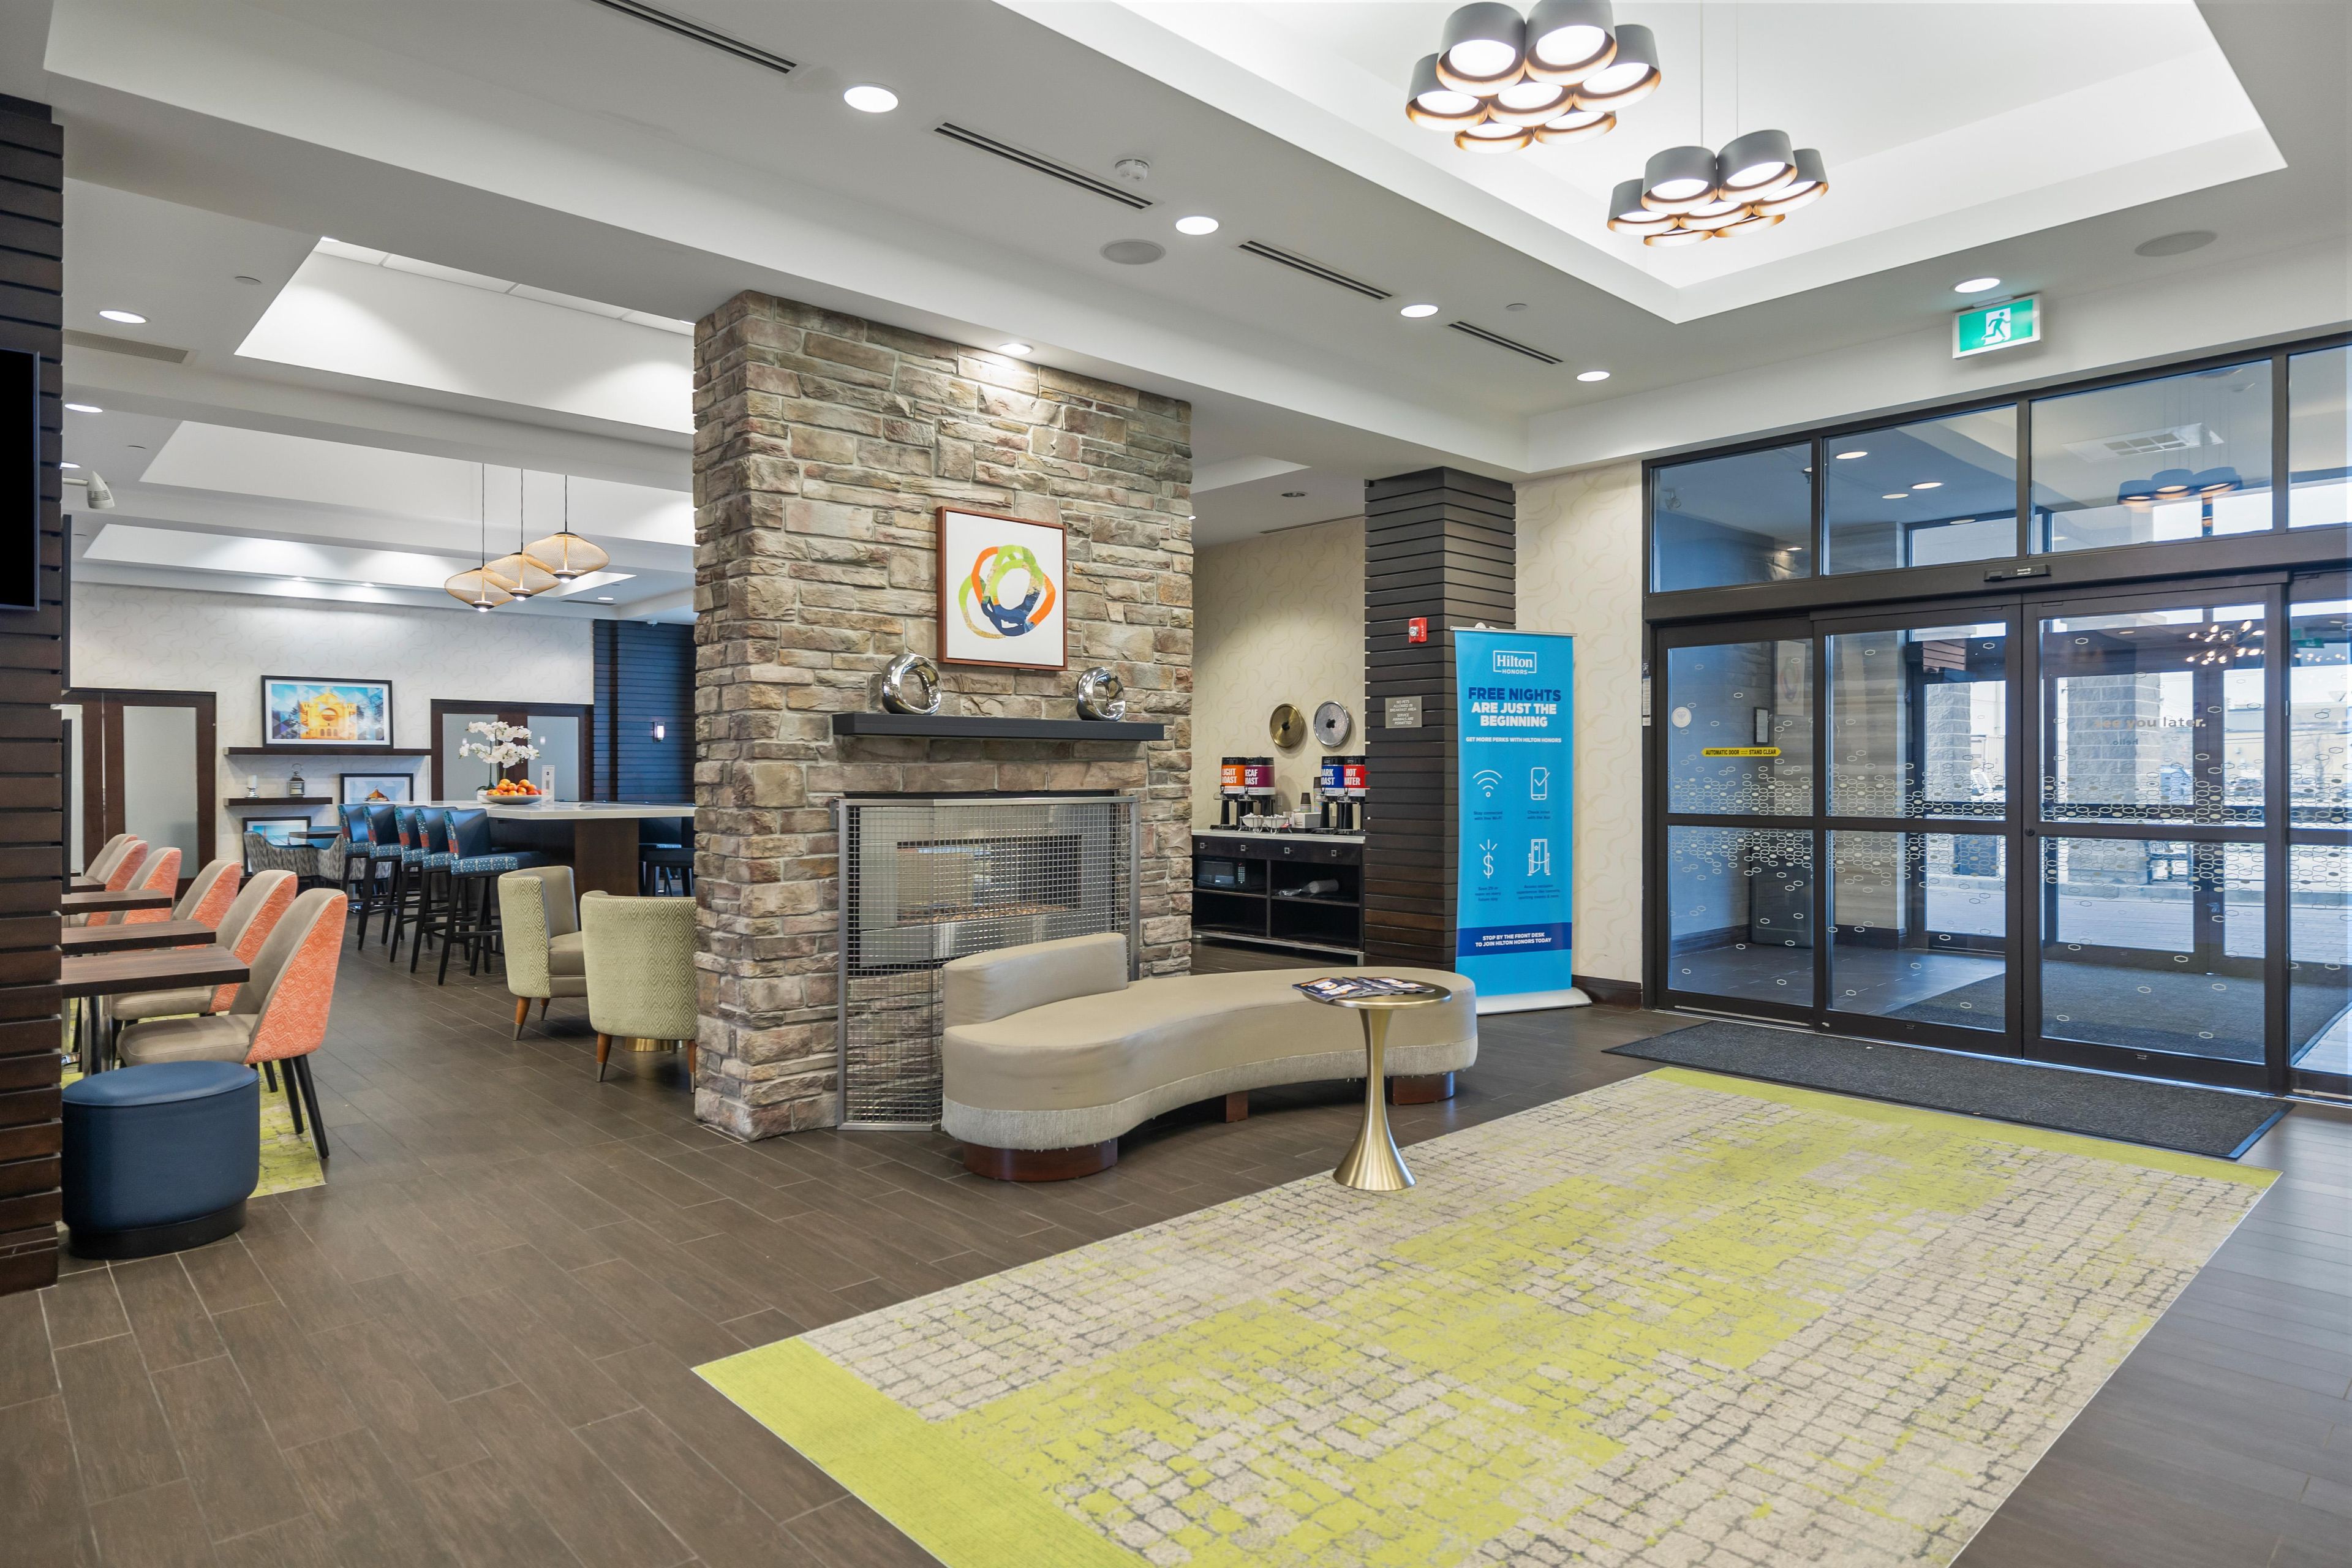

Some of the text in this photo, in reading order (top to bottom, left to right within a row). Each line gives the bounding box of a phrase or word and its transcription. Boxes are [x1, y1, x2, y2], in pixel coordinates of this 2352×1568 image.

[1497, 655, 1533, 668] Hilton
[1468, 687, 1561, 701] FREE NIGHTS
[1471, 702, 1557, 715] ARE JUST THE
[1480, 715, 1548, 727] BEGINNING
[2126, 718, 2156, 730] you
[2163, 716, 2206, 728] later.
[1346, 768, 1357, 777] HOT
